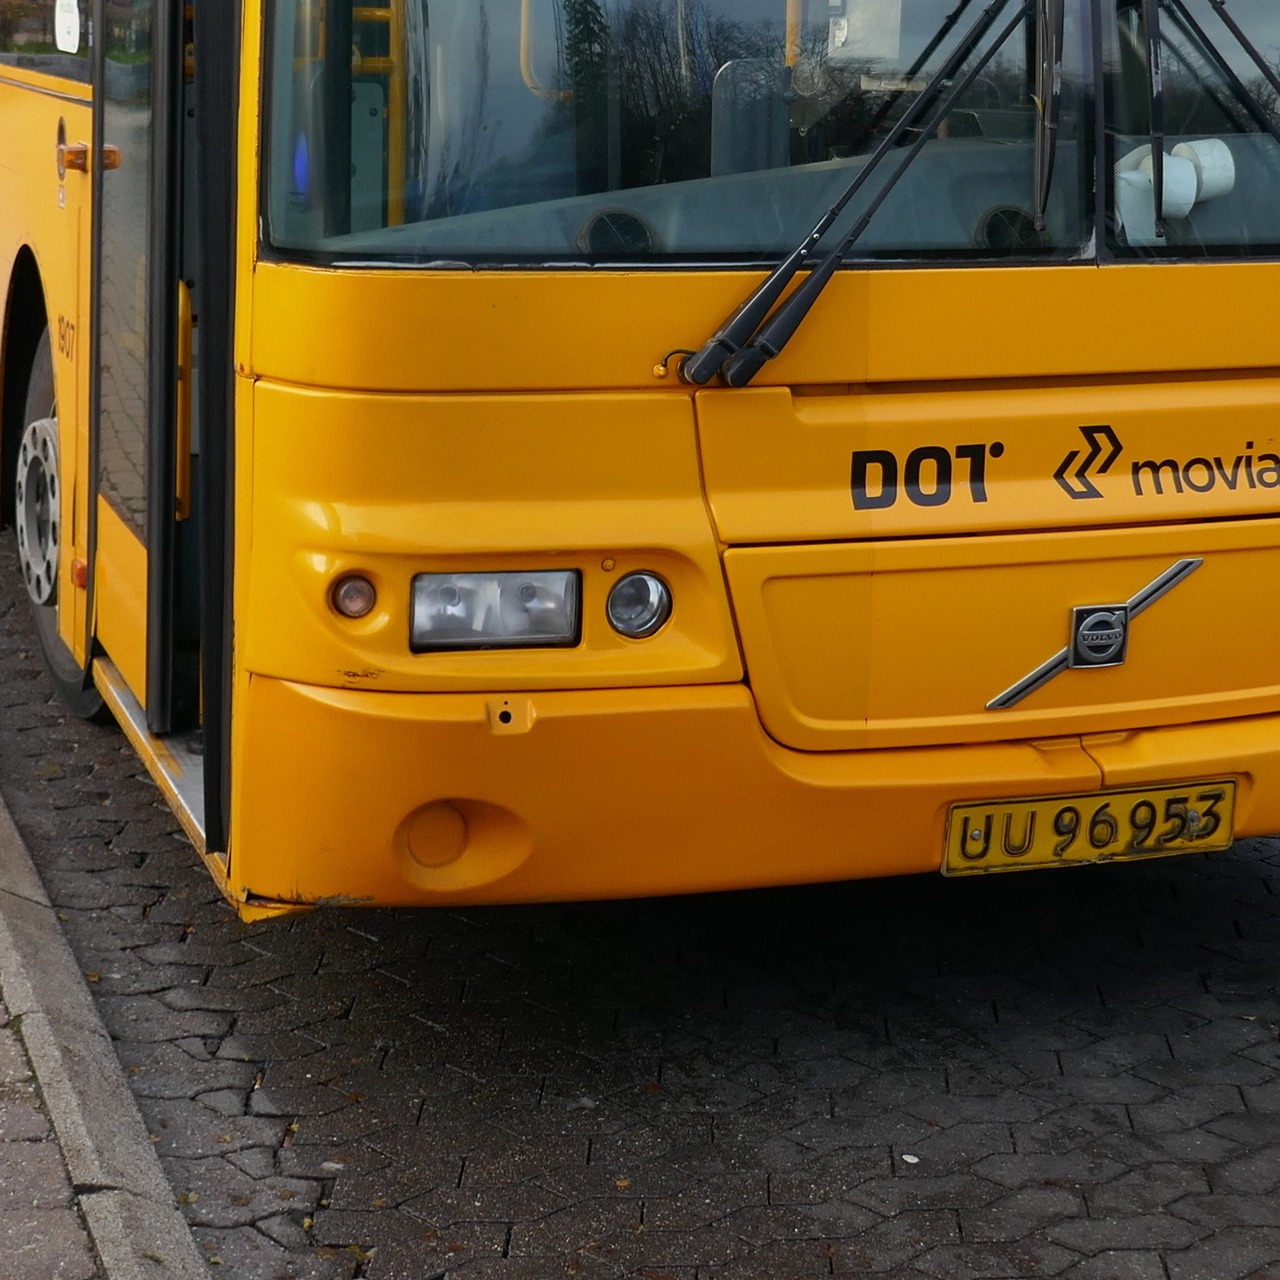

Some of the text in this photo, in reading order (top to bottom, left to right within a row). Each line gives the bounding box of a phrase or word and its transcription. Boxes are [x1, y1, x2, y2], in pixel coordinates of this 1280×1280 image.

[850, 441, 1006, 511] DOT
[1081, 632, 1122, 643] VOLVO
[960, 809, 1037, 861] UU
